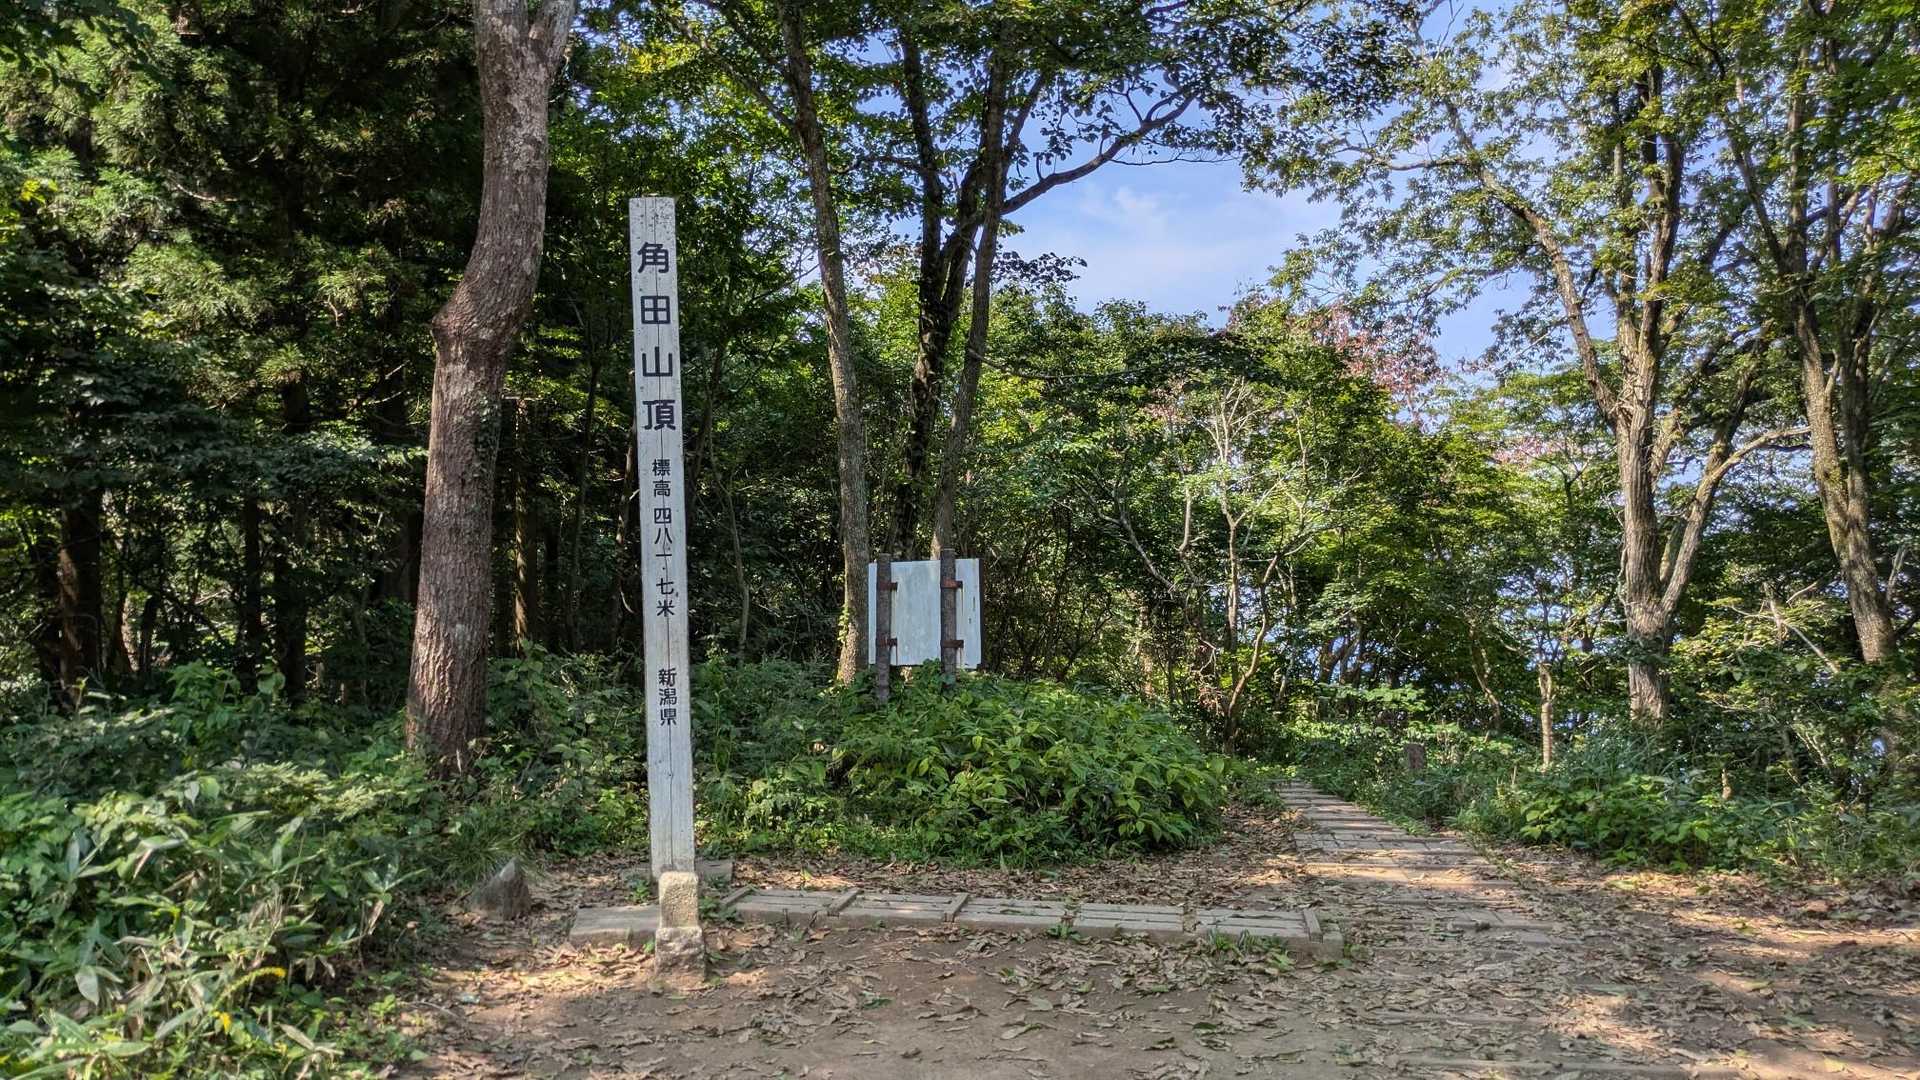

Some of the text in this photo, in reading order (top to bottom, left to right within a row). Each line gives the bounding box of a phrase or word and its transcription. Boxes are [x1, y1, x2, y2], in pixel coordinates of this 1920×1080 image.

[637, 242, 677, 430] 角田山頂
[657, 667, 678, 726] 新潟県
